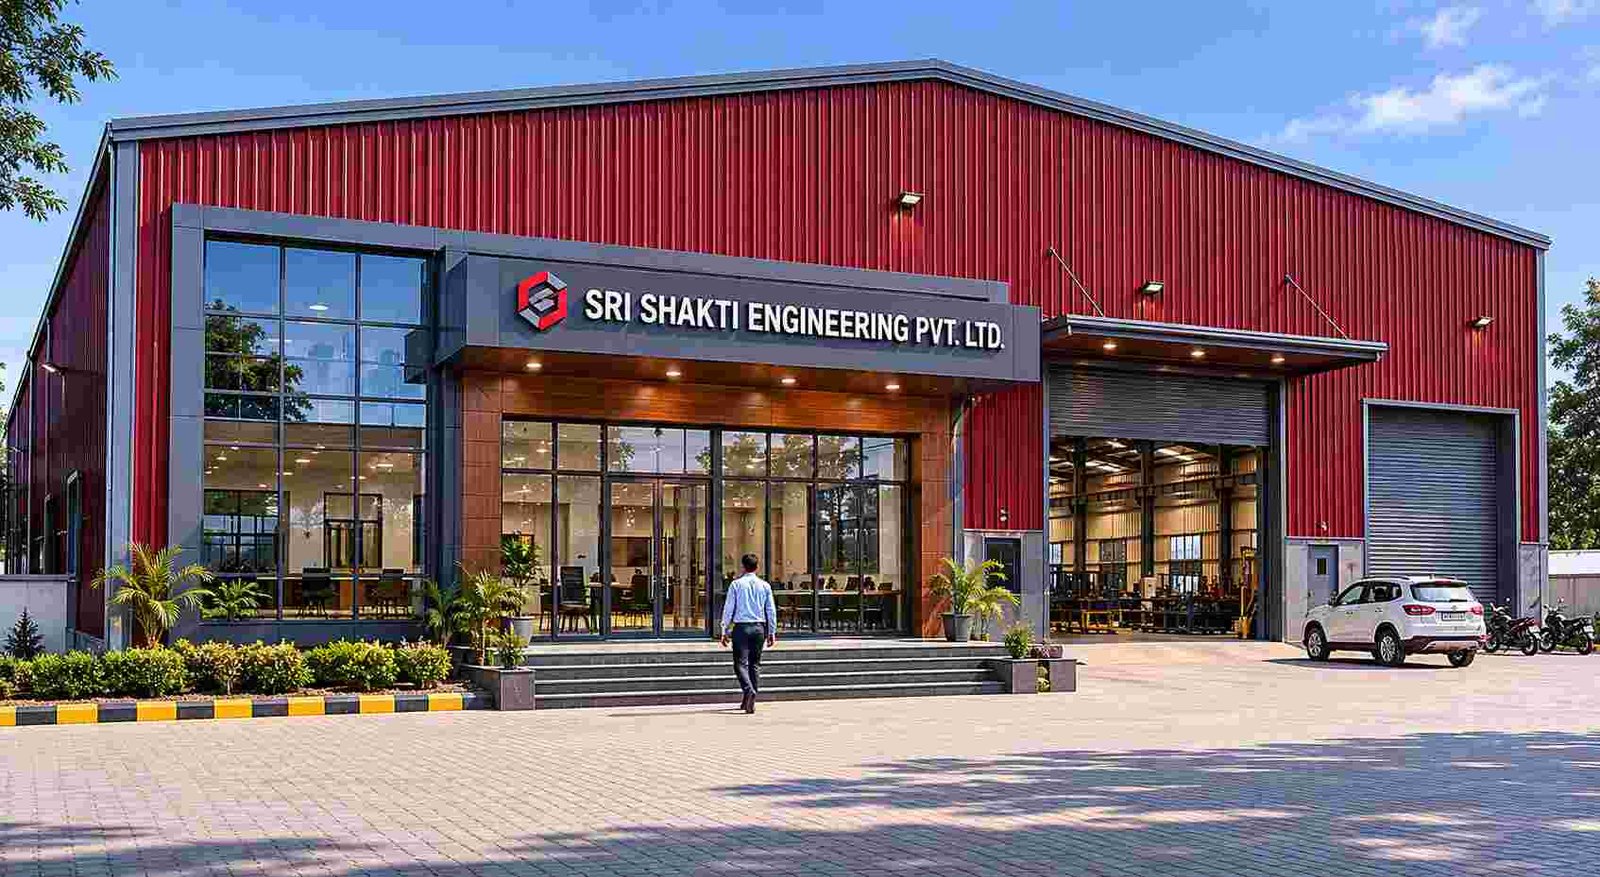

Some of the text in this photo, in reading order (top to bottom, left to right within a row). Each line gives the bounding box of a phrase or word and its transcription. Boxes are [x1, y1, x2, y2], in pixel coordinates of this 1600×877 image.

[585, 289, 1006, 349] SRI SHAKTI ENGINEERING PVT. LTD.
